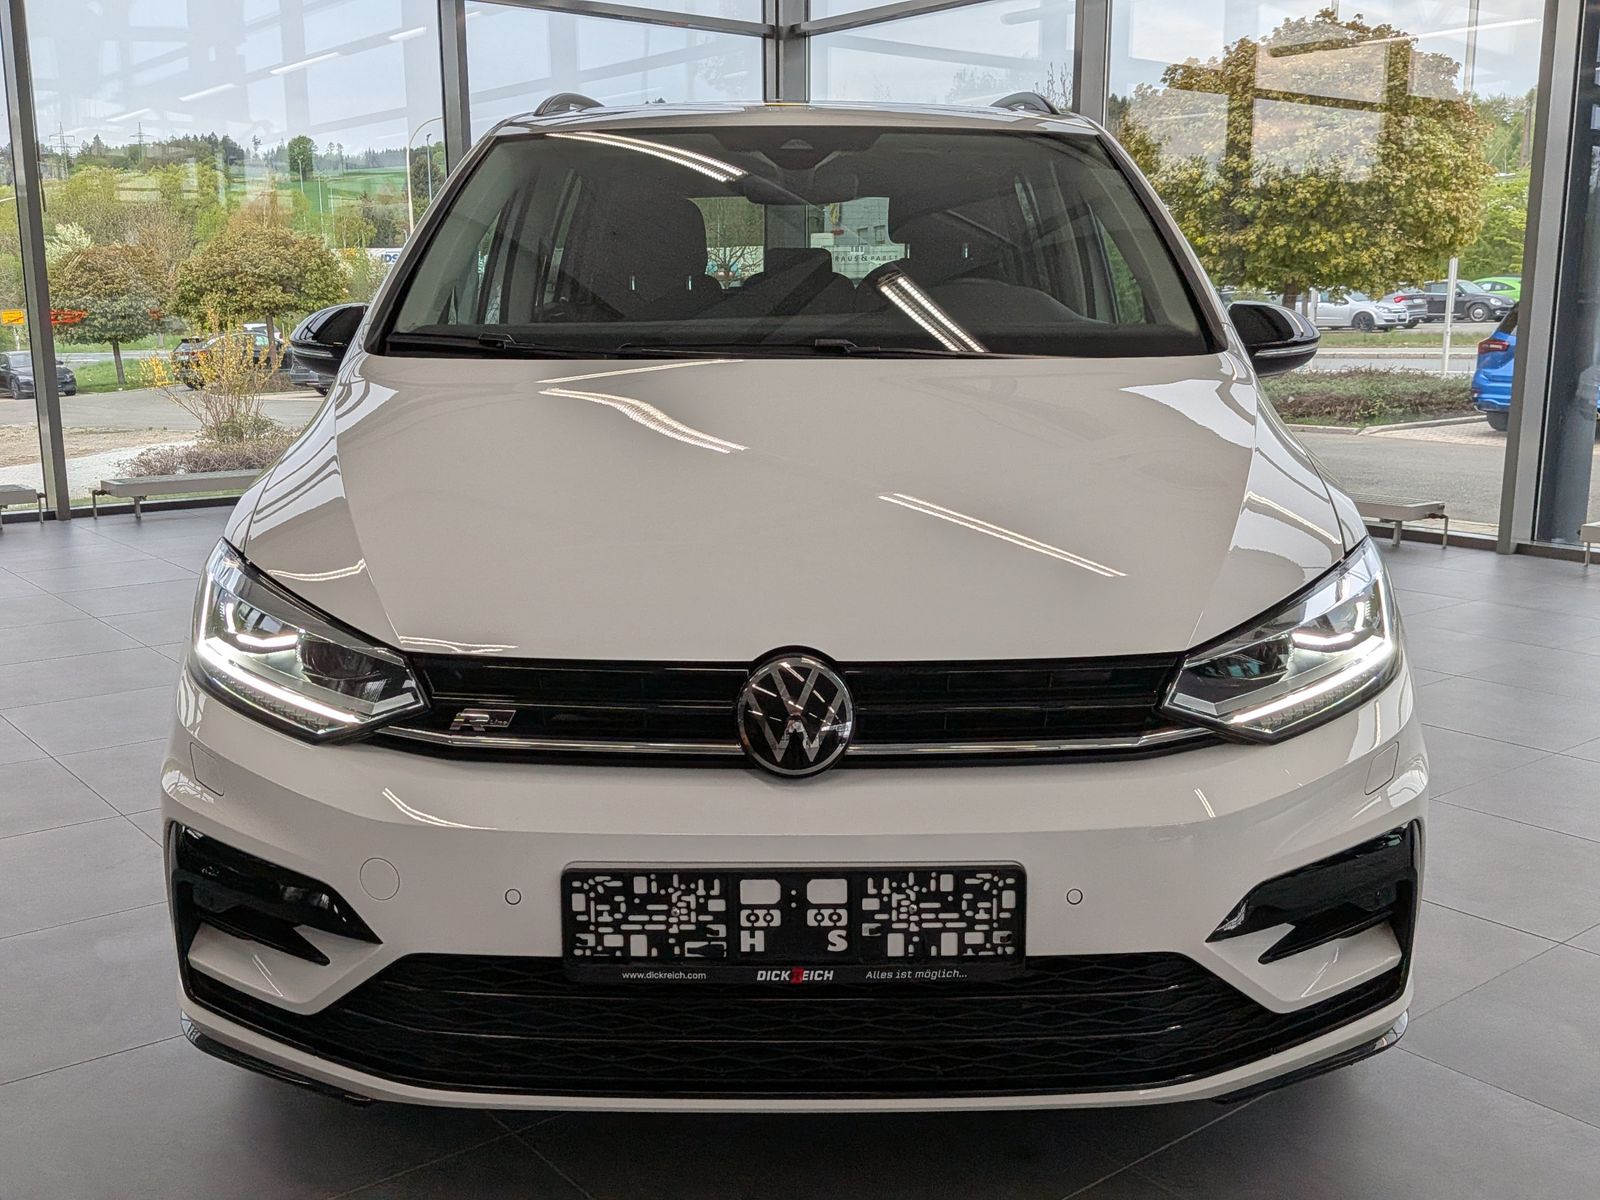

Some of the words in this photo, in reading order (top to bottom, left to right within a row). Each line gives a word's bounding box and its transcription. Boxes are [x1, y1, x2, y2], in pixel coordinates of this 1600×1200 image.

[621, 970, 707, 980] www.dickreich.com
[865, 970, 894, 980] Alles
[895, 969, 913, 979] ist
